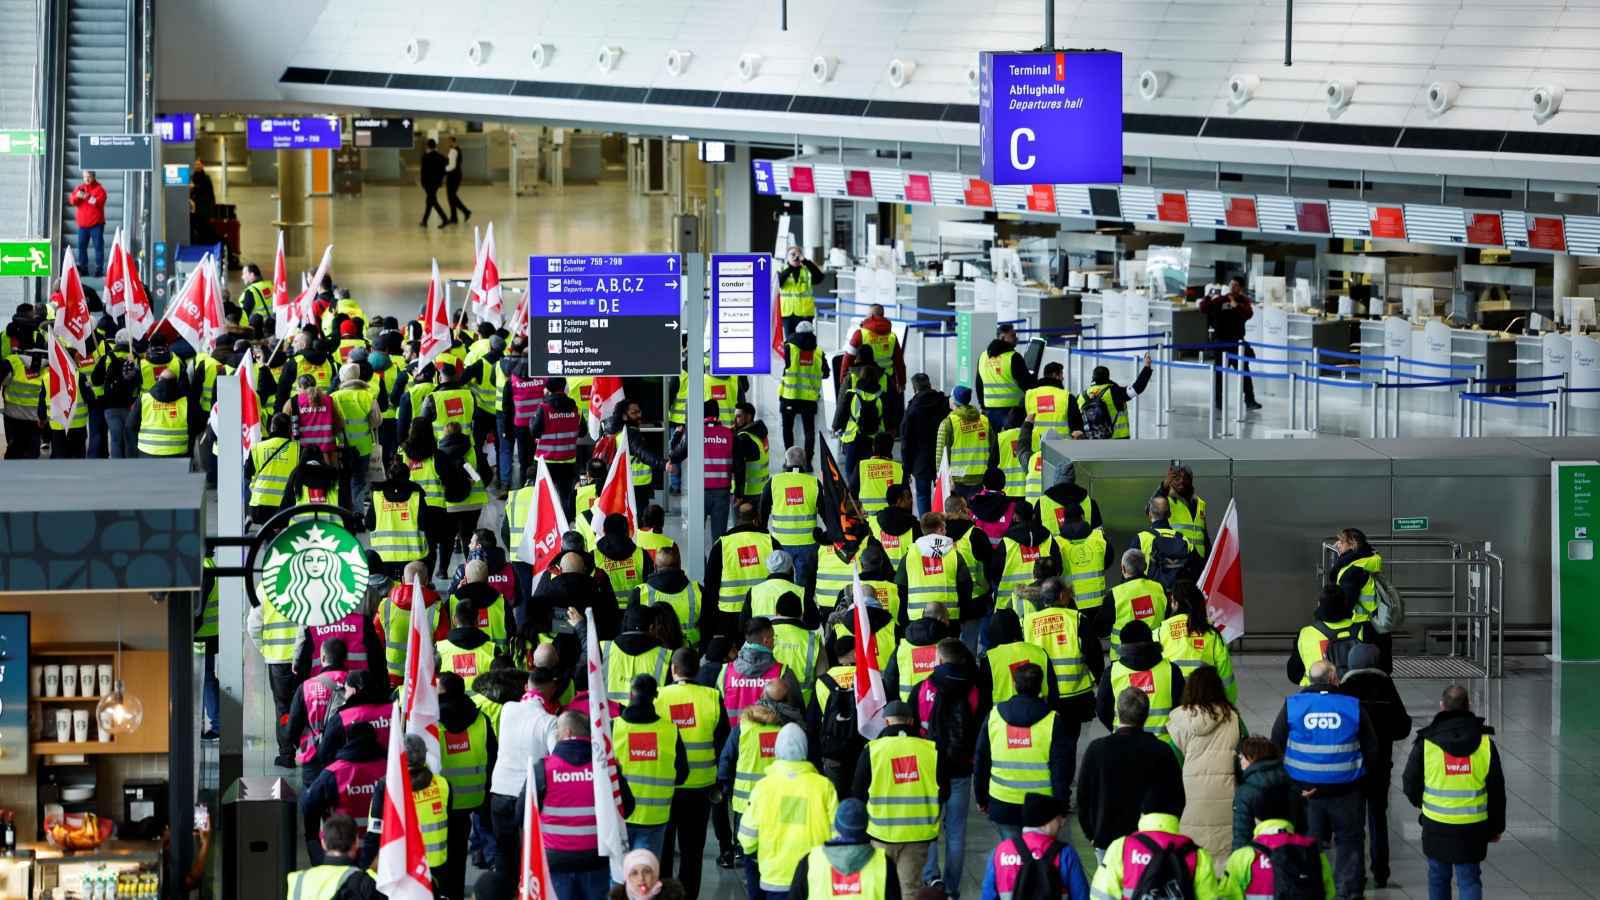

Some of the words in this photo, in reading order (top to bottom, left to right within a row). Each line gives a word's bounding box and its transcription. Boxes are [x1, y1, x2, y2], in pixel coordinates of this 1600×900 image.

[1009, 65, 1050, 75] Terminal
[1057, 64, 1062, 75] 1
[1009, 84, 1065, 96] Abflughalle
[1009, 98, 1061, 111] Departures
[1064, 98, 1083, 109] hall
[292, 120, 300, 132] C
[1010, 127, 1036, 170] C
[563, 279, 582, 287] Abflug
[548, 411, 576, 419] komba
[1135, 607, 1153, 616] ver.di
[316, 622, 356, 636] komba
[672, 717, 694, 725] ver.di
[448, 741, 468, 750] ver.di
[1008, 737, 1030, 745] ver.di
[632, 749, 656, 758] ver.di
[1447, 763, 1470, 772] ver.di
[553, 768, 593, 783] komb
[895, 771, 918, 779] ver.di
[833, 883, 860, 892] ver.di
